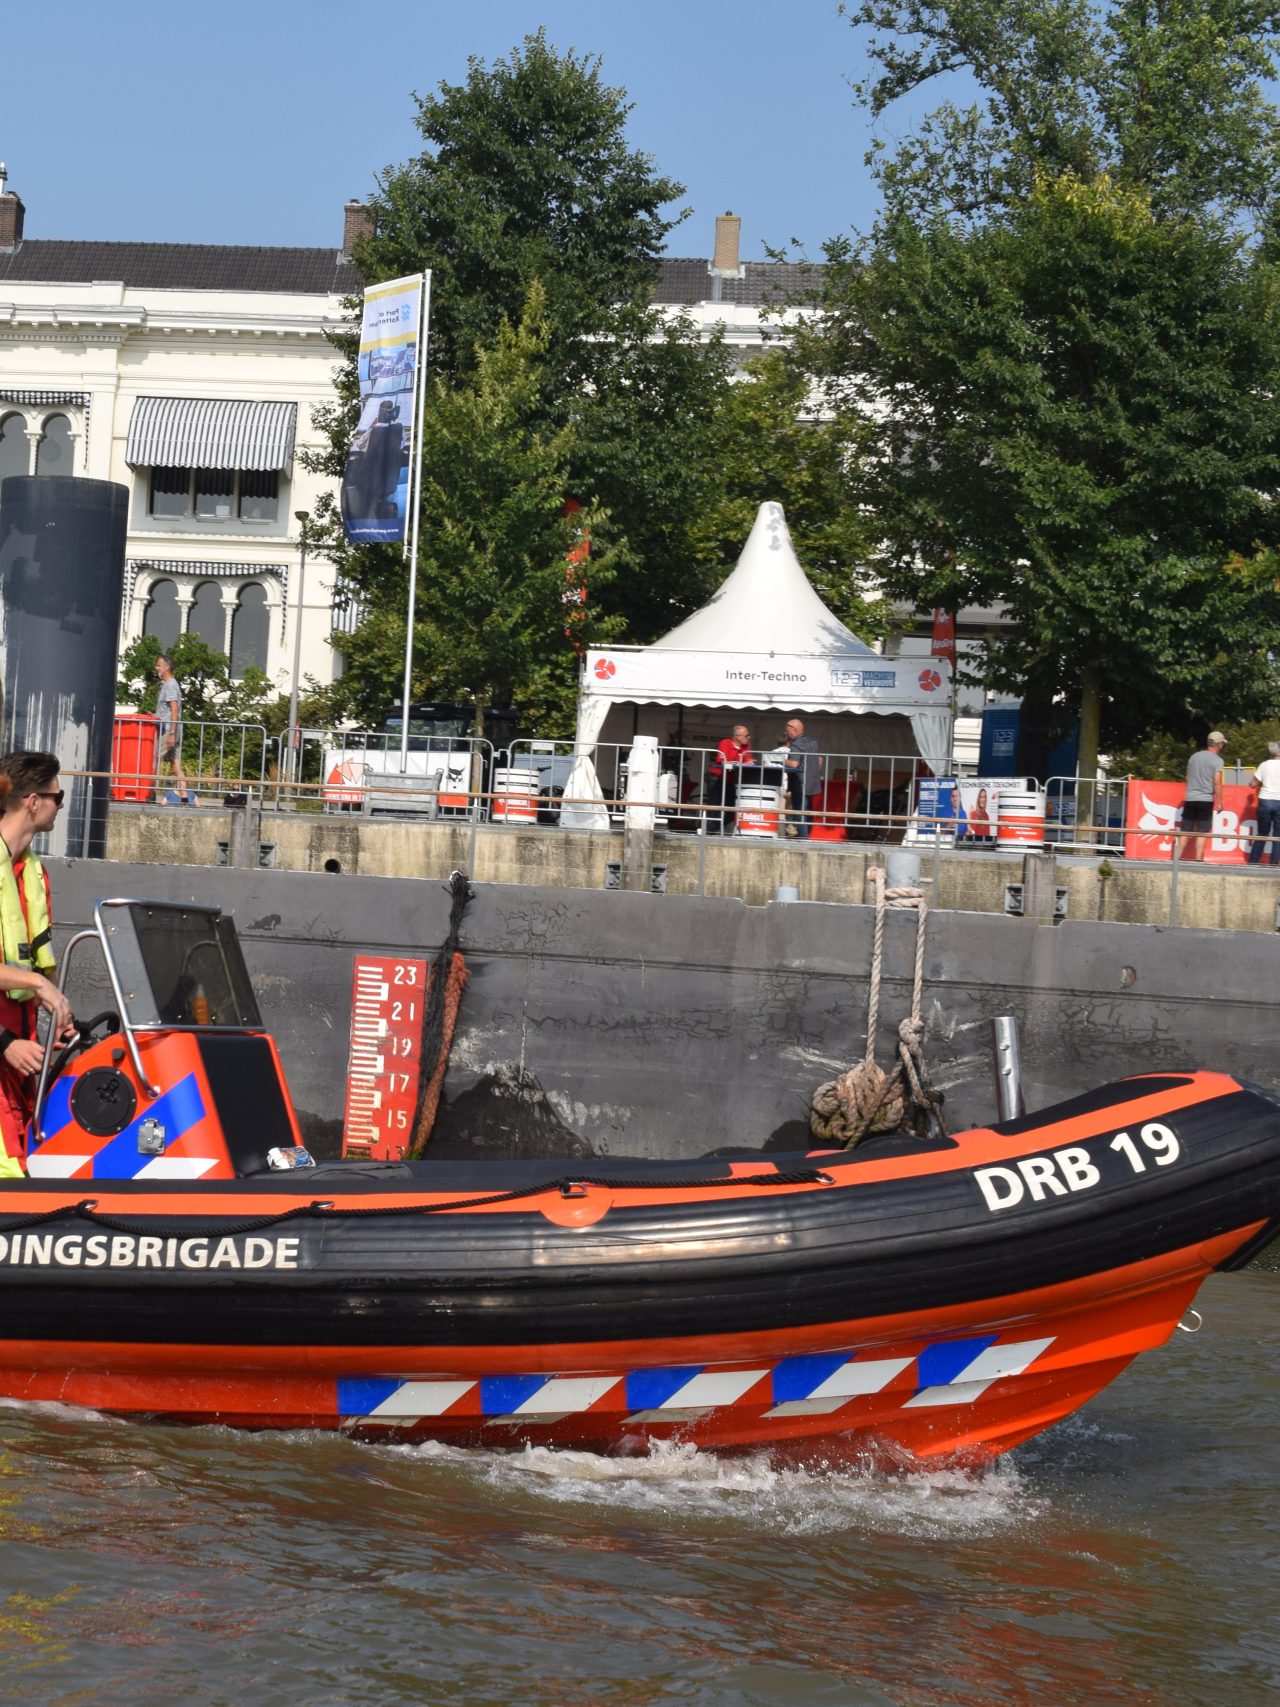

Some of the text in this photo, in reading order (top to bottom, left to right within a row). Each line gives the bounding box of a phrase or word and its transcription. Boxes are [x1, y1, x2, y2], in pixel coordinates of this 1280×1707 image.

[726, 670, 807, 682] Inter-Techno
[394, 965, 417, 985] 23
[391, 1001, 415, 1021] 21
[392, 1037, 412, 1057] 19
[389, 1073, 410, 1093] 17
[386, 1109, 408, 1129] 15
[973, 1122, 1180, 1211] DRB 19
